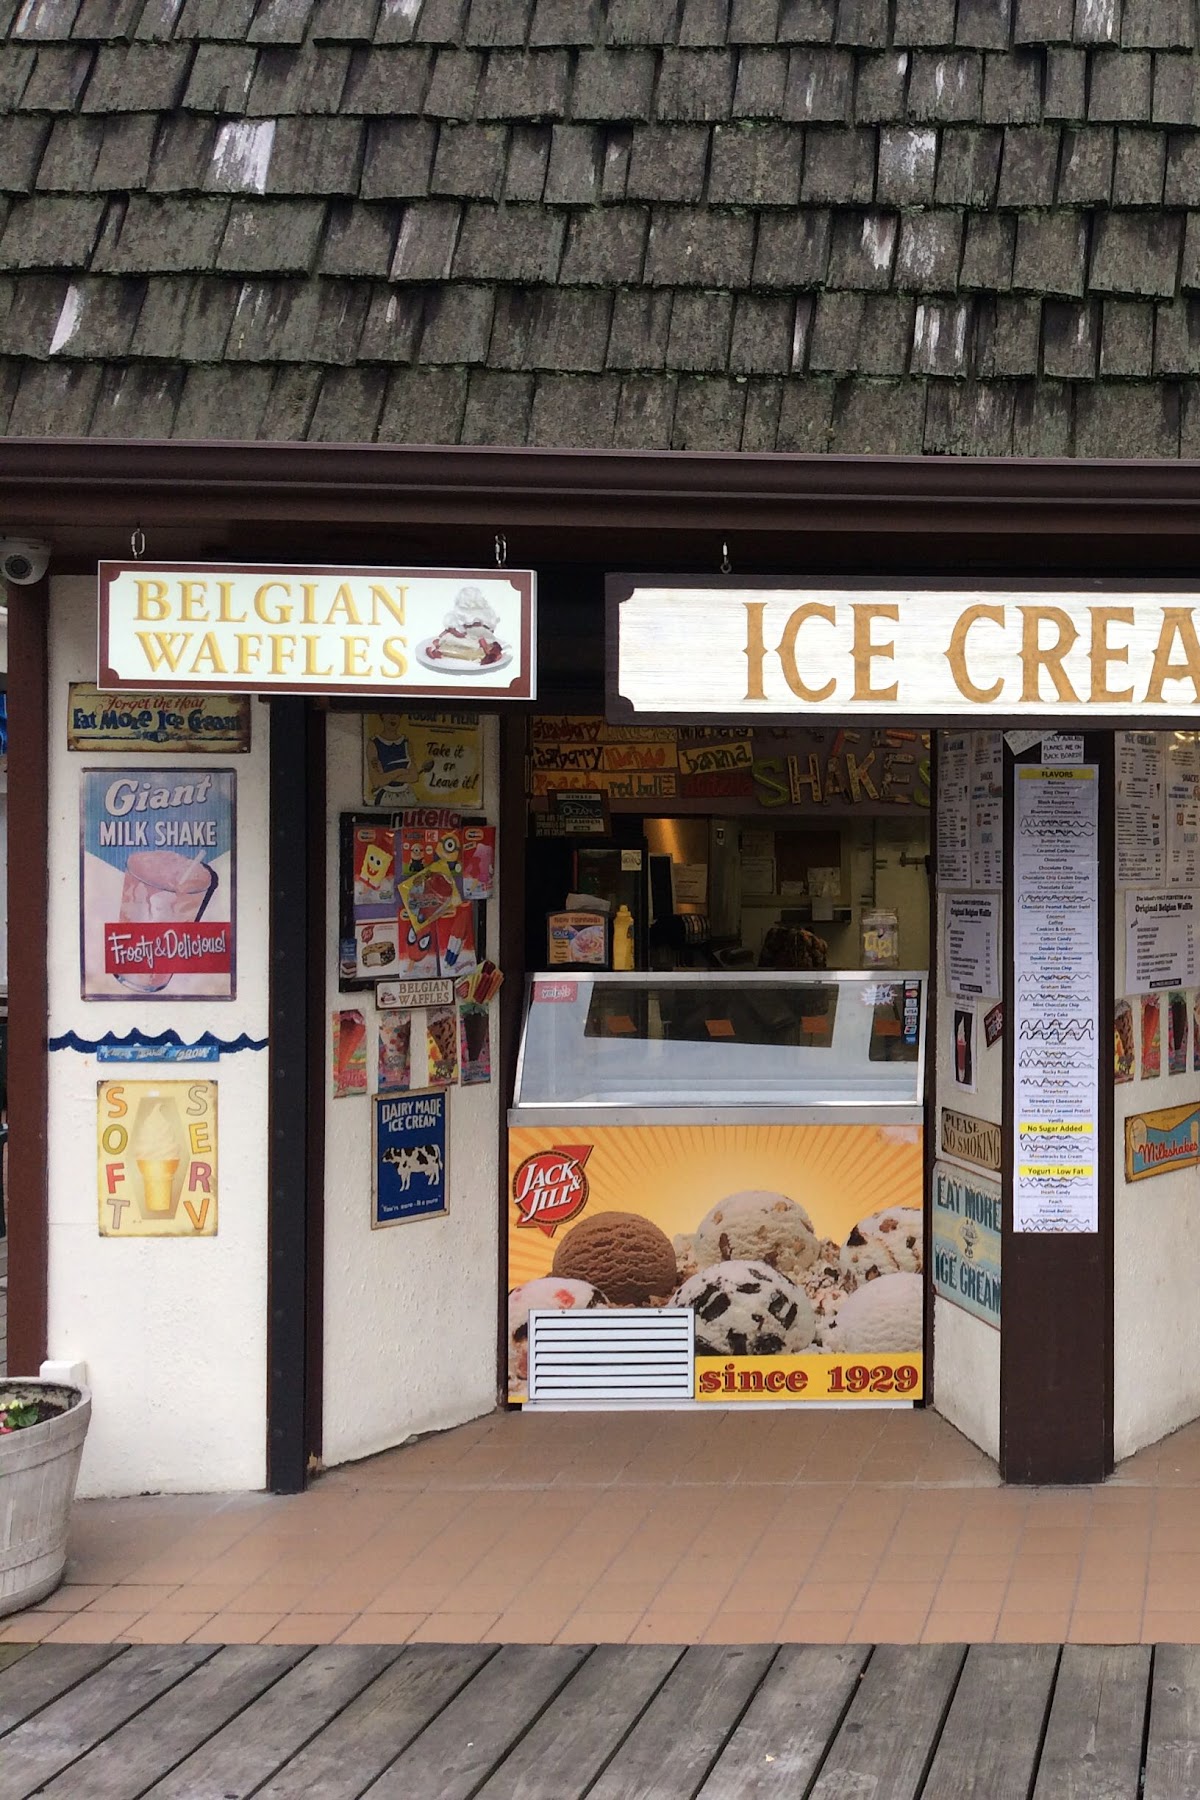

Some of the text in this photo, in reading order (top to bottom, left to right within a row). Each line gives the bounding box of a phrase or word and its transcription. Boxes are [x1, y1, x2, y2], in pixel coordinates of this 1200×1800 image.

[133, 579, 410, 627] BELGIAN
[135, 630, 410, 679] WAFFLES
[742, 602, 899, 703] ICE
[153, 695, 172, 709] the
[73, 708, 242, 733] Eat More Ice Cream
[426, 742, 465, 758] Take it
[682, 745, 751, 774] banana
[429, 773, 480, 789] Leave it!
[443, 762, 456, 773] or
[104, 775, 213, 817] Giant
[391, 808, 463, 830] nutella
[100, 820, 217, 847] MILK SHAKE
[1135, 902, 1193, 914] Original Belgian Waffle
[107, 931, 154, 968] Frosty
[164, 928, 227, 960] Delicious!
[398, 991, 449, 1005] WAFFLES
[399, 981, 449, 996] BELGIAN
[382, 1098, 442, 1125] DAIRY MADE
[388, 1114, 436, 1133] ICE CREAM
[945, 1113, 980, 1134] PLEASE
[1028, 1125, 1083, 1134] No Sugar Added
[102, 1086, 131, 1230] SOFT
[183, 1085, 213, 1230] SERV
[943, 1123, 956, 1151] NO
[957, 1128, 1000, 1166] SMOKING
[1139, 1141, 1199, 1164] Milkshakes
[514, 1159, 584, 1204] JACK &
[1028, 1167, 1084, 1176] Yogurt Low Fat
[520, 1181, 572, 1223] JILL
[937, 1174, 1001, 1233] EAT MORE
[935, 1250, 957, 1291] ICE
[700, 1363, 919, 1393] since 1929
